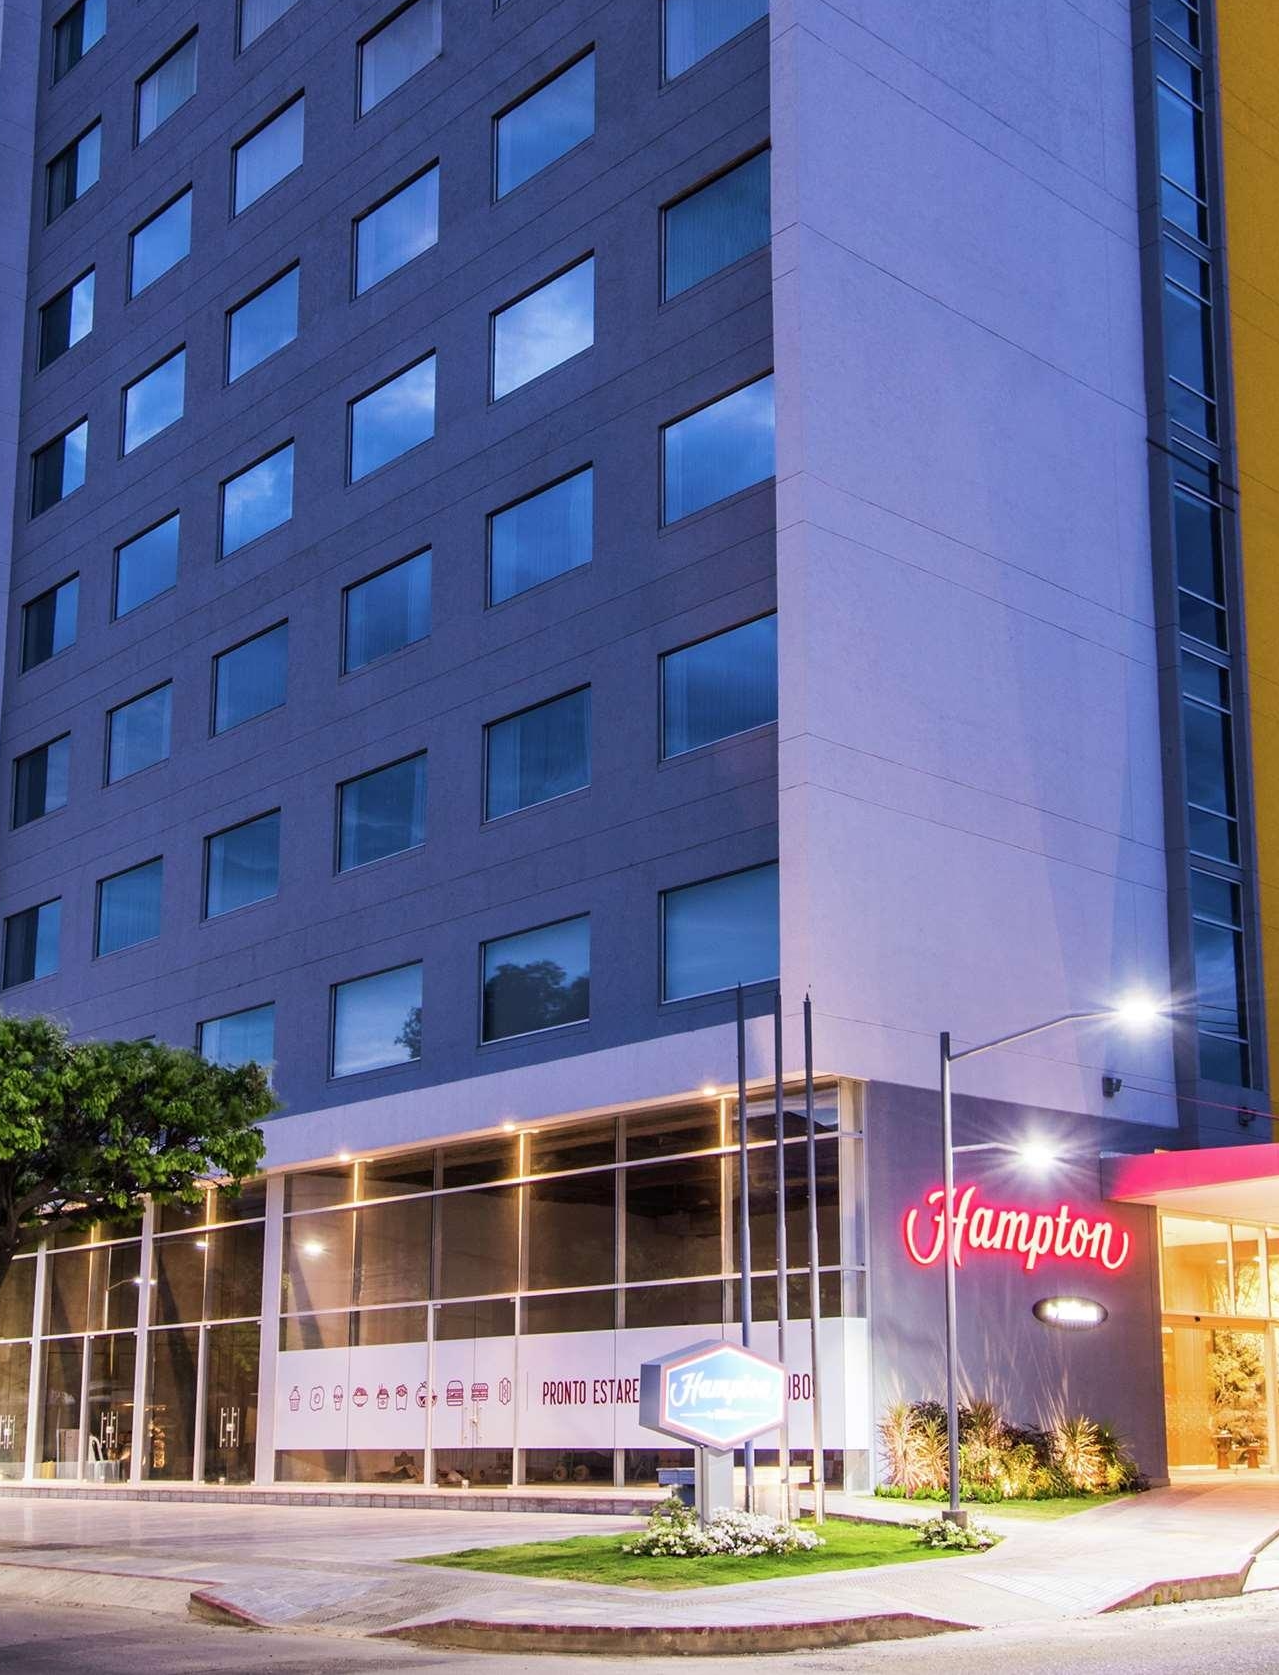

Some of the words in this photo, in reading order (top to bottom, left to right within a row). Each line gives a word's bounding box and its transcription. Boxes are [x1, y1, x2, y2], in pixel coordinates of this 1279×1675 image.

[907, 1185, 1129, 1270] Hampton
[542, 1381, 587, 1405] PRONTO
[593, 1378, 640, 1404] ESTARE
